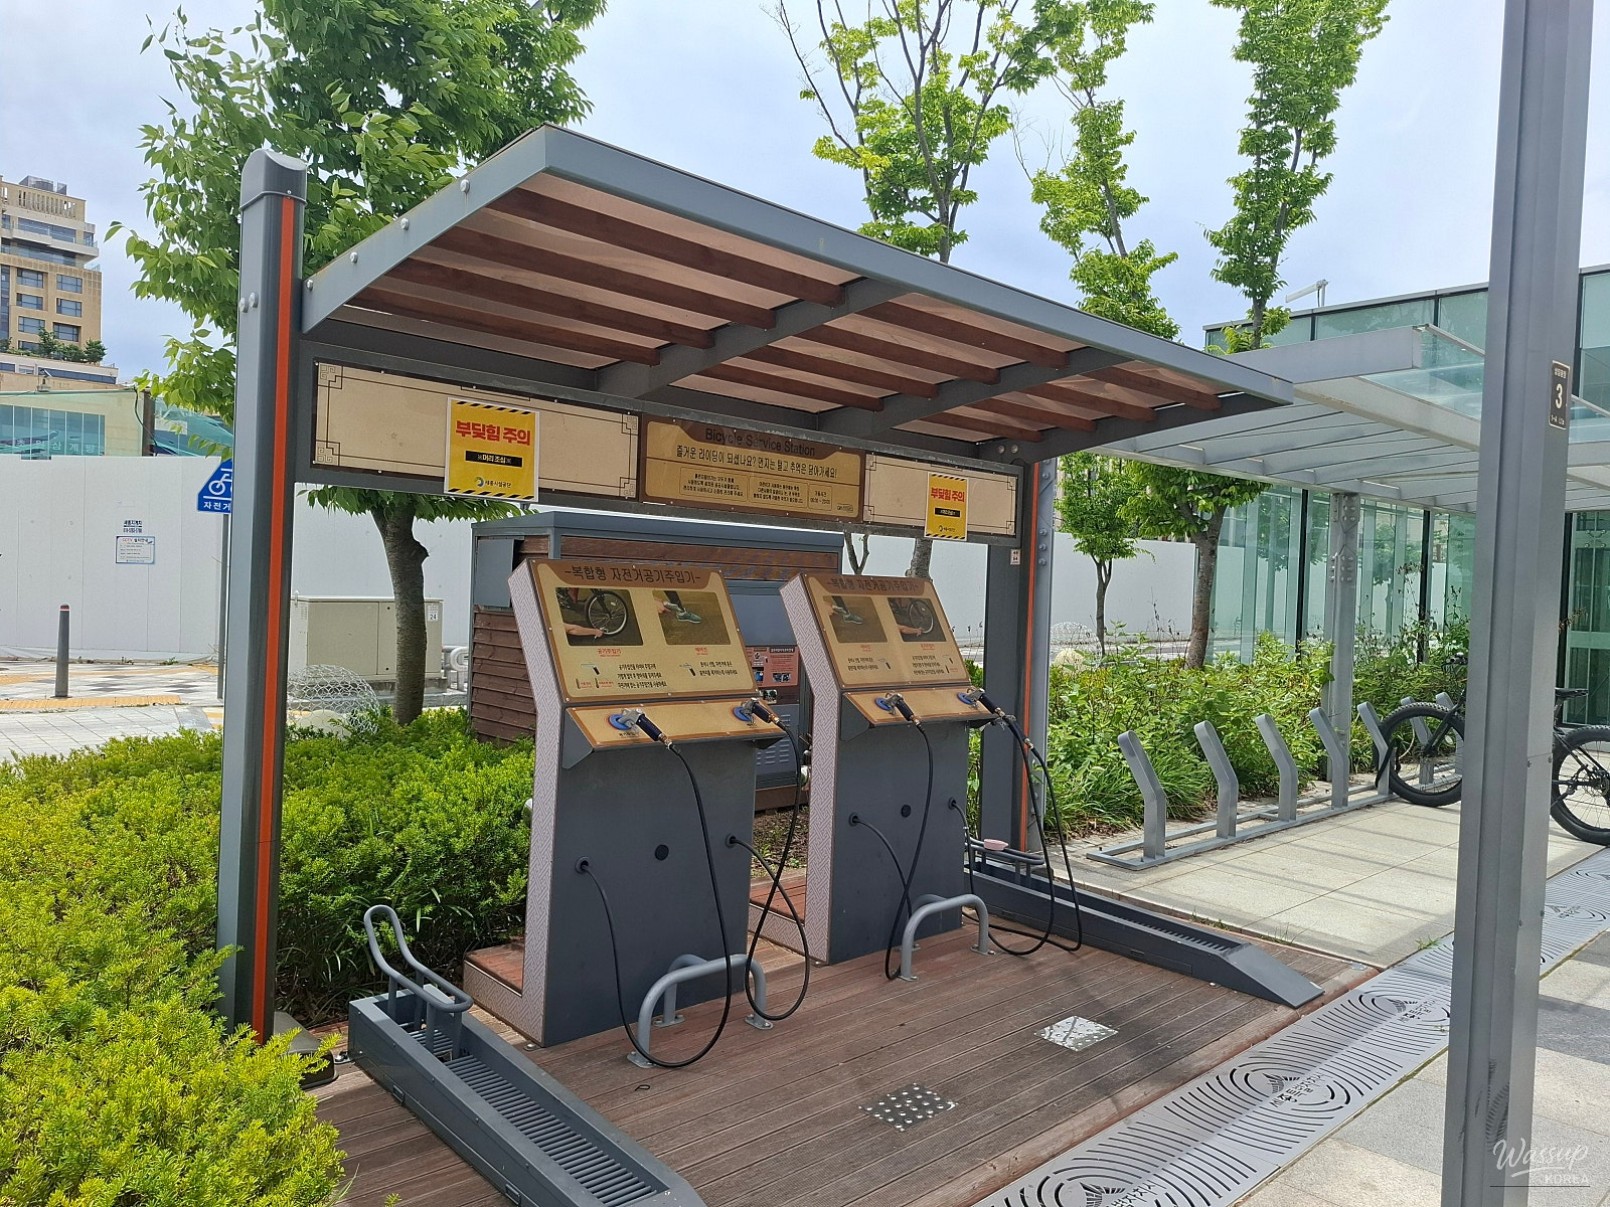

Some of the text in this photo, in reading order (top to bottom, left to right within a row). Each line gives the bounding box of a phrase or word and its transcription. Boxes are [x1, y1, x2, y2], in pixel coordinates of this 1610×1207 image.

[1555, 383, 1563, 409] 3
[456, 420, 531, 446] 부딪힘 주의
[785, 441, 815, 456] Station
[676, 445, 697, 459] 즐거운
[699, 448, 725, 463] 라이딩이
[758, 457, 776, 470] 먼지는
[790, 461, 807, 475] 추억은
[808, 464, 838, 478] 담아가세요!
[203, 501, 231, 511] 자전거
[952, 490, 964, 502] 주의
